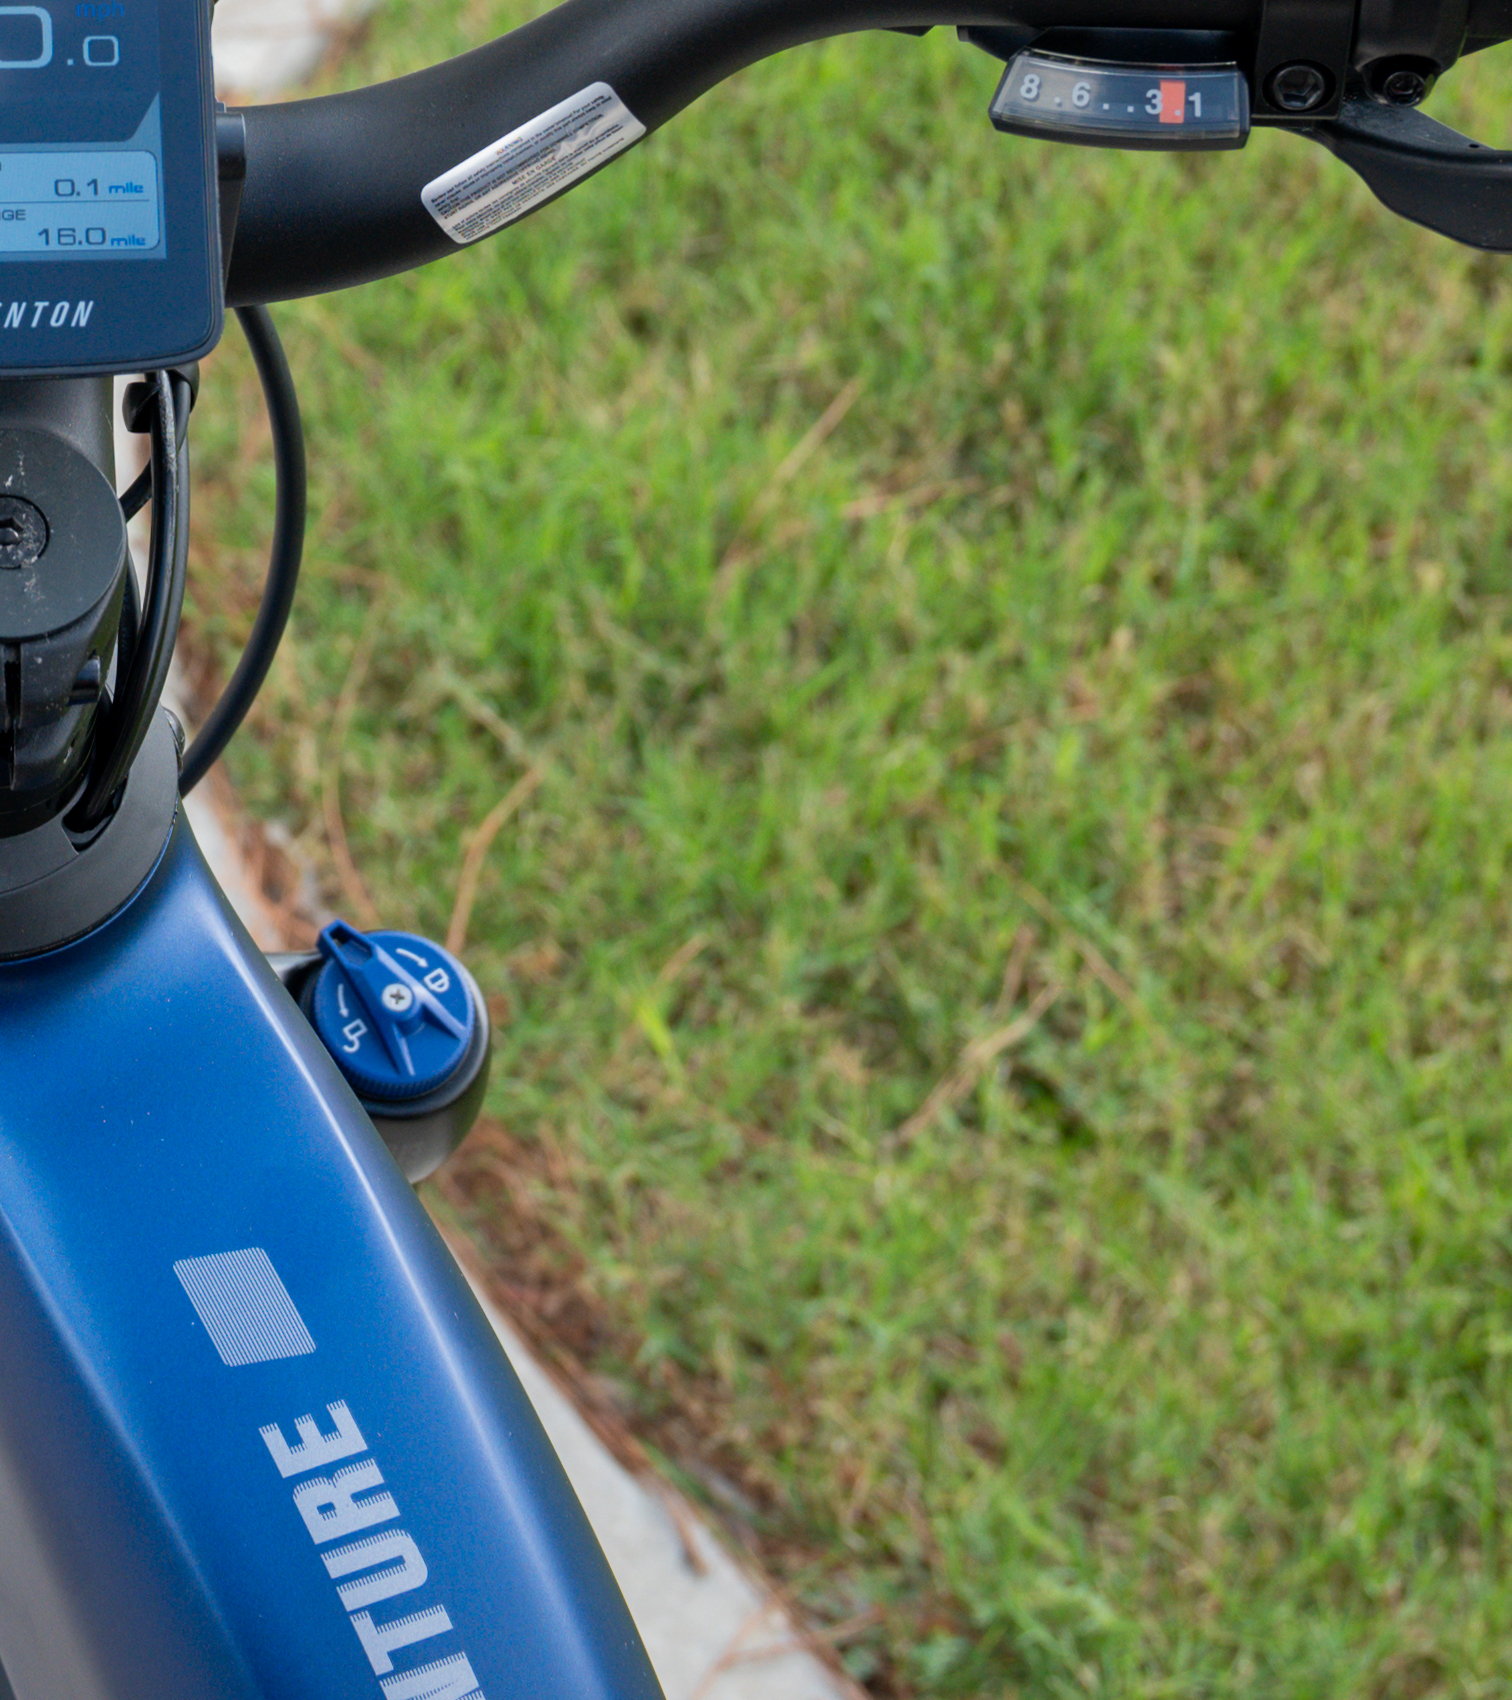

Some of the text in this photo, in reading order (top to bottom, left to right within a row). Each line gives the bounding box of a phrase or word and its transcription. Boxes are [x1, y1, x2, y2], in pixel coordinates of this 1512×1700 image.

[76, 0, 125, 19] mph
[525, 168, 535, 176] EN
[54, 178, 145, 197] 0.1 mile
[38, 227, 146, 247] 16.0 mile
